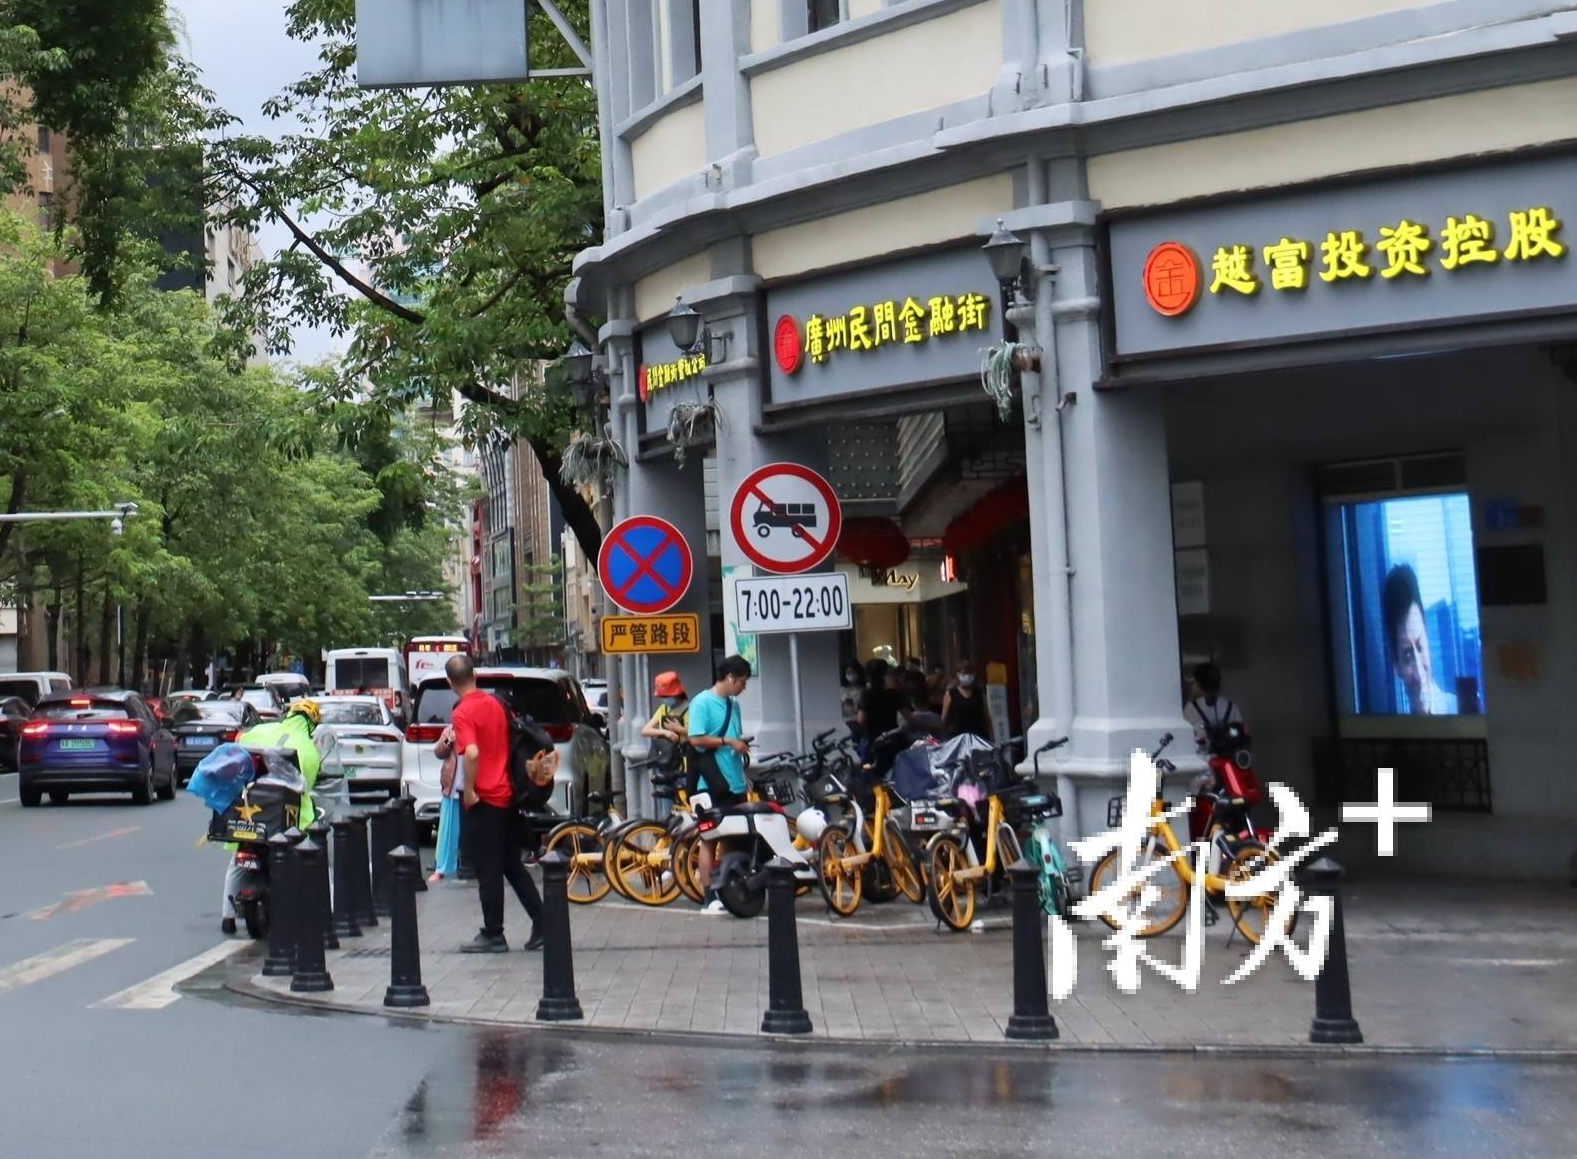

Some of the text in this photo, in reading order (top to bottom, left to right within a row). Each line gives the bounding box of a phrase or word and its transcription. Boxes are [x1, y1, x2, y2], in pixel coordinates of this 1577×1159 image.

[1209, 207, 1564, 296] 越富投资控股
[805, 293, 986, 364] 廣州民間金融街
[740, 584, 844, 622] 7:00-22:00
[609, 622, 692, 647] 严管路段
